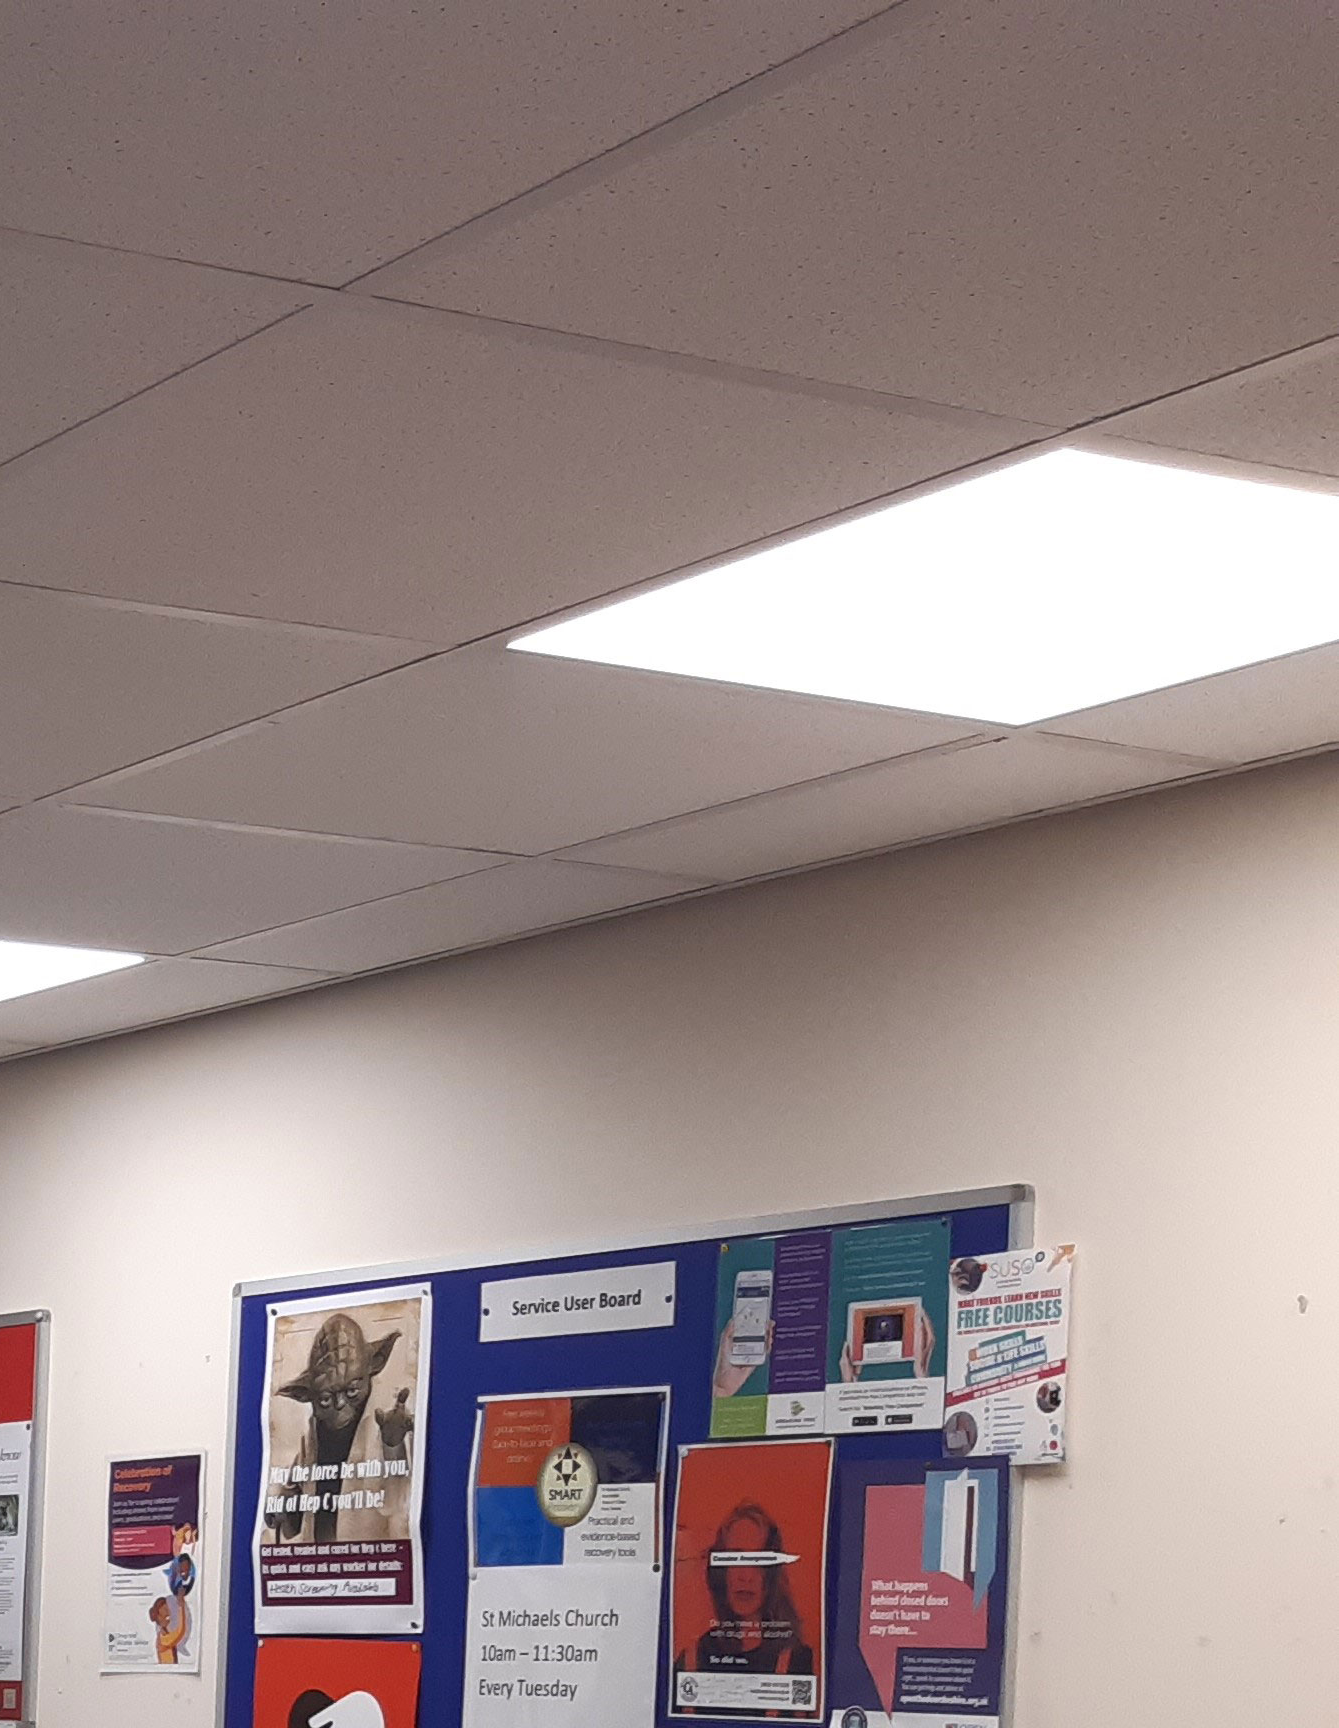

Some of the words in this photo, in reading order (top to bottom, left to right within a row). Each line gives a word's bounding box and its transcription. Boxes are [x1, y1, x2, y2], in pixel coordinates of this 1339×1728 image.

[512, 1298, 560, 1316] Service
[564, 1295, 596, 1311] User
[599, 1289, 642, 1308] Board
[957, 1307, 990, 1329] FREE
[993, 1299, 1062, 1325] COURSES
[1, 1448, 21, 1461] know
[114, 1467, 161, 1479] Celebration
[162, 1465, 173, 1475] of
[270, 1467, 291, 1485] May
[292, 1465, 309, 1482] the
[311, 1463, 338, 1481] force
[340, 1462, 354, 1478] be
[357, 1459, 381, 1477] with
[384, 1459, 409, 1478] you,
[113, 1482, 151, 1493] Recovery
[549, 1488, 584, 1501] SMART
[266, 1496, 284, 1513] Rid
[286, 1495, 298, 1512] of
[299, 1494, 320, 1513] Hep
[323, 1493, 331, 1510] C
[332, 1491, 363, 1512] you'll
[365, 1490, 384, 1508] be!
[588, 1516, 618, 1526] Practical
[620, 1516, 634, 1525] and
[580, 1532, 640, 1542] evidence-based
[584, 1548, 616, 1558] recovery
[618, 1548, 636, 1557] tools
[481, 1611, 495, 1627] St
[498, 1609, 560, 1628] Michaels
[565, 1609, 619, 1627] Church
[481, 1645, 516, 1661] 10am
[533, 1645, 598, 1662] 11:30am
[721, 1655, 734, 1664] did
[479, 1679, 514, 1700] Every
[518, 1679, 577, 1701] Tuesday
